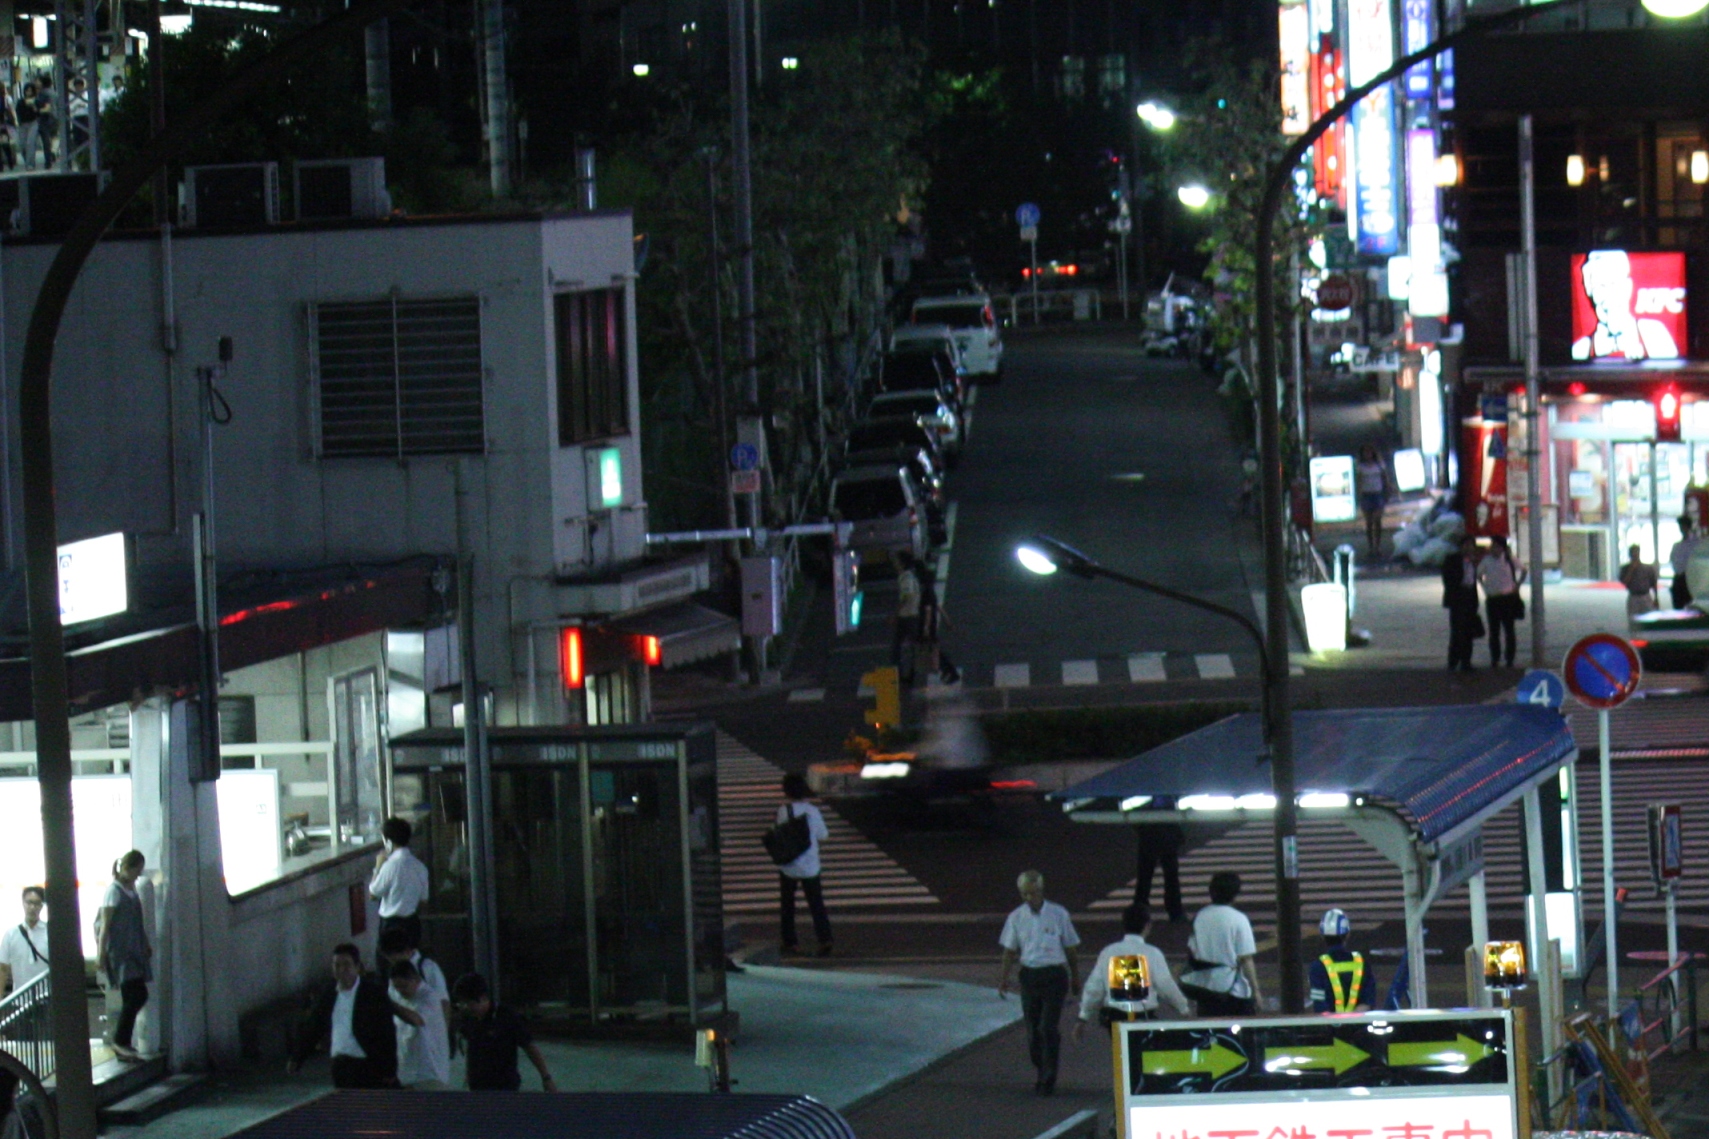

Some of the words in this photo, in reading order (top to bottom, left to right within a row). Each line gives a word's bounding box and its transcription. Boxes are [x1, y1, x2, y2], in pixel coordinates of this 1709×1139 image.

[1634, 287, 1686, 314] KFC
[1530, 680, 1551, 707] 4
[639, 743, 676, 758] ISDN
